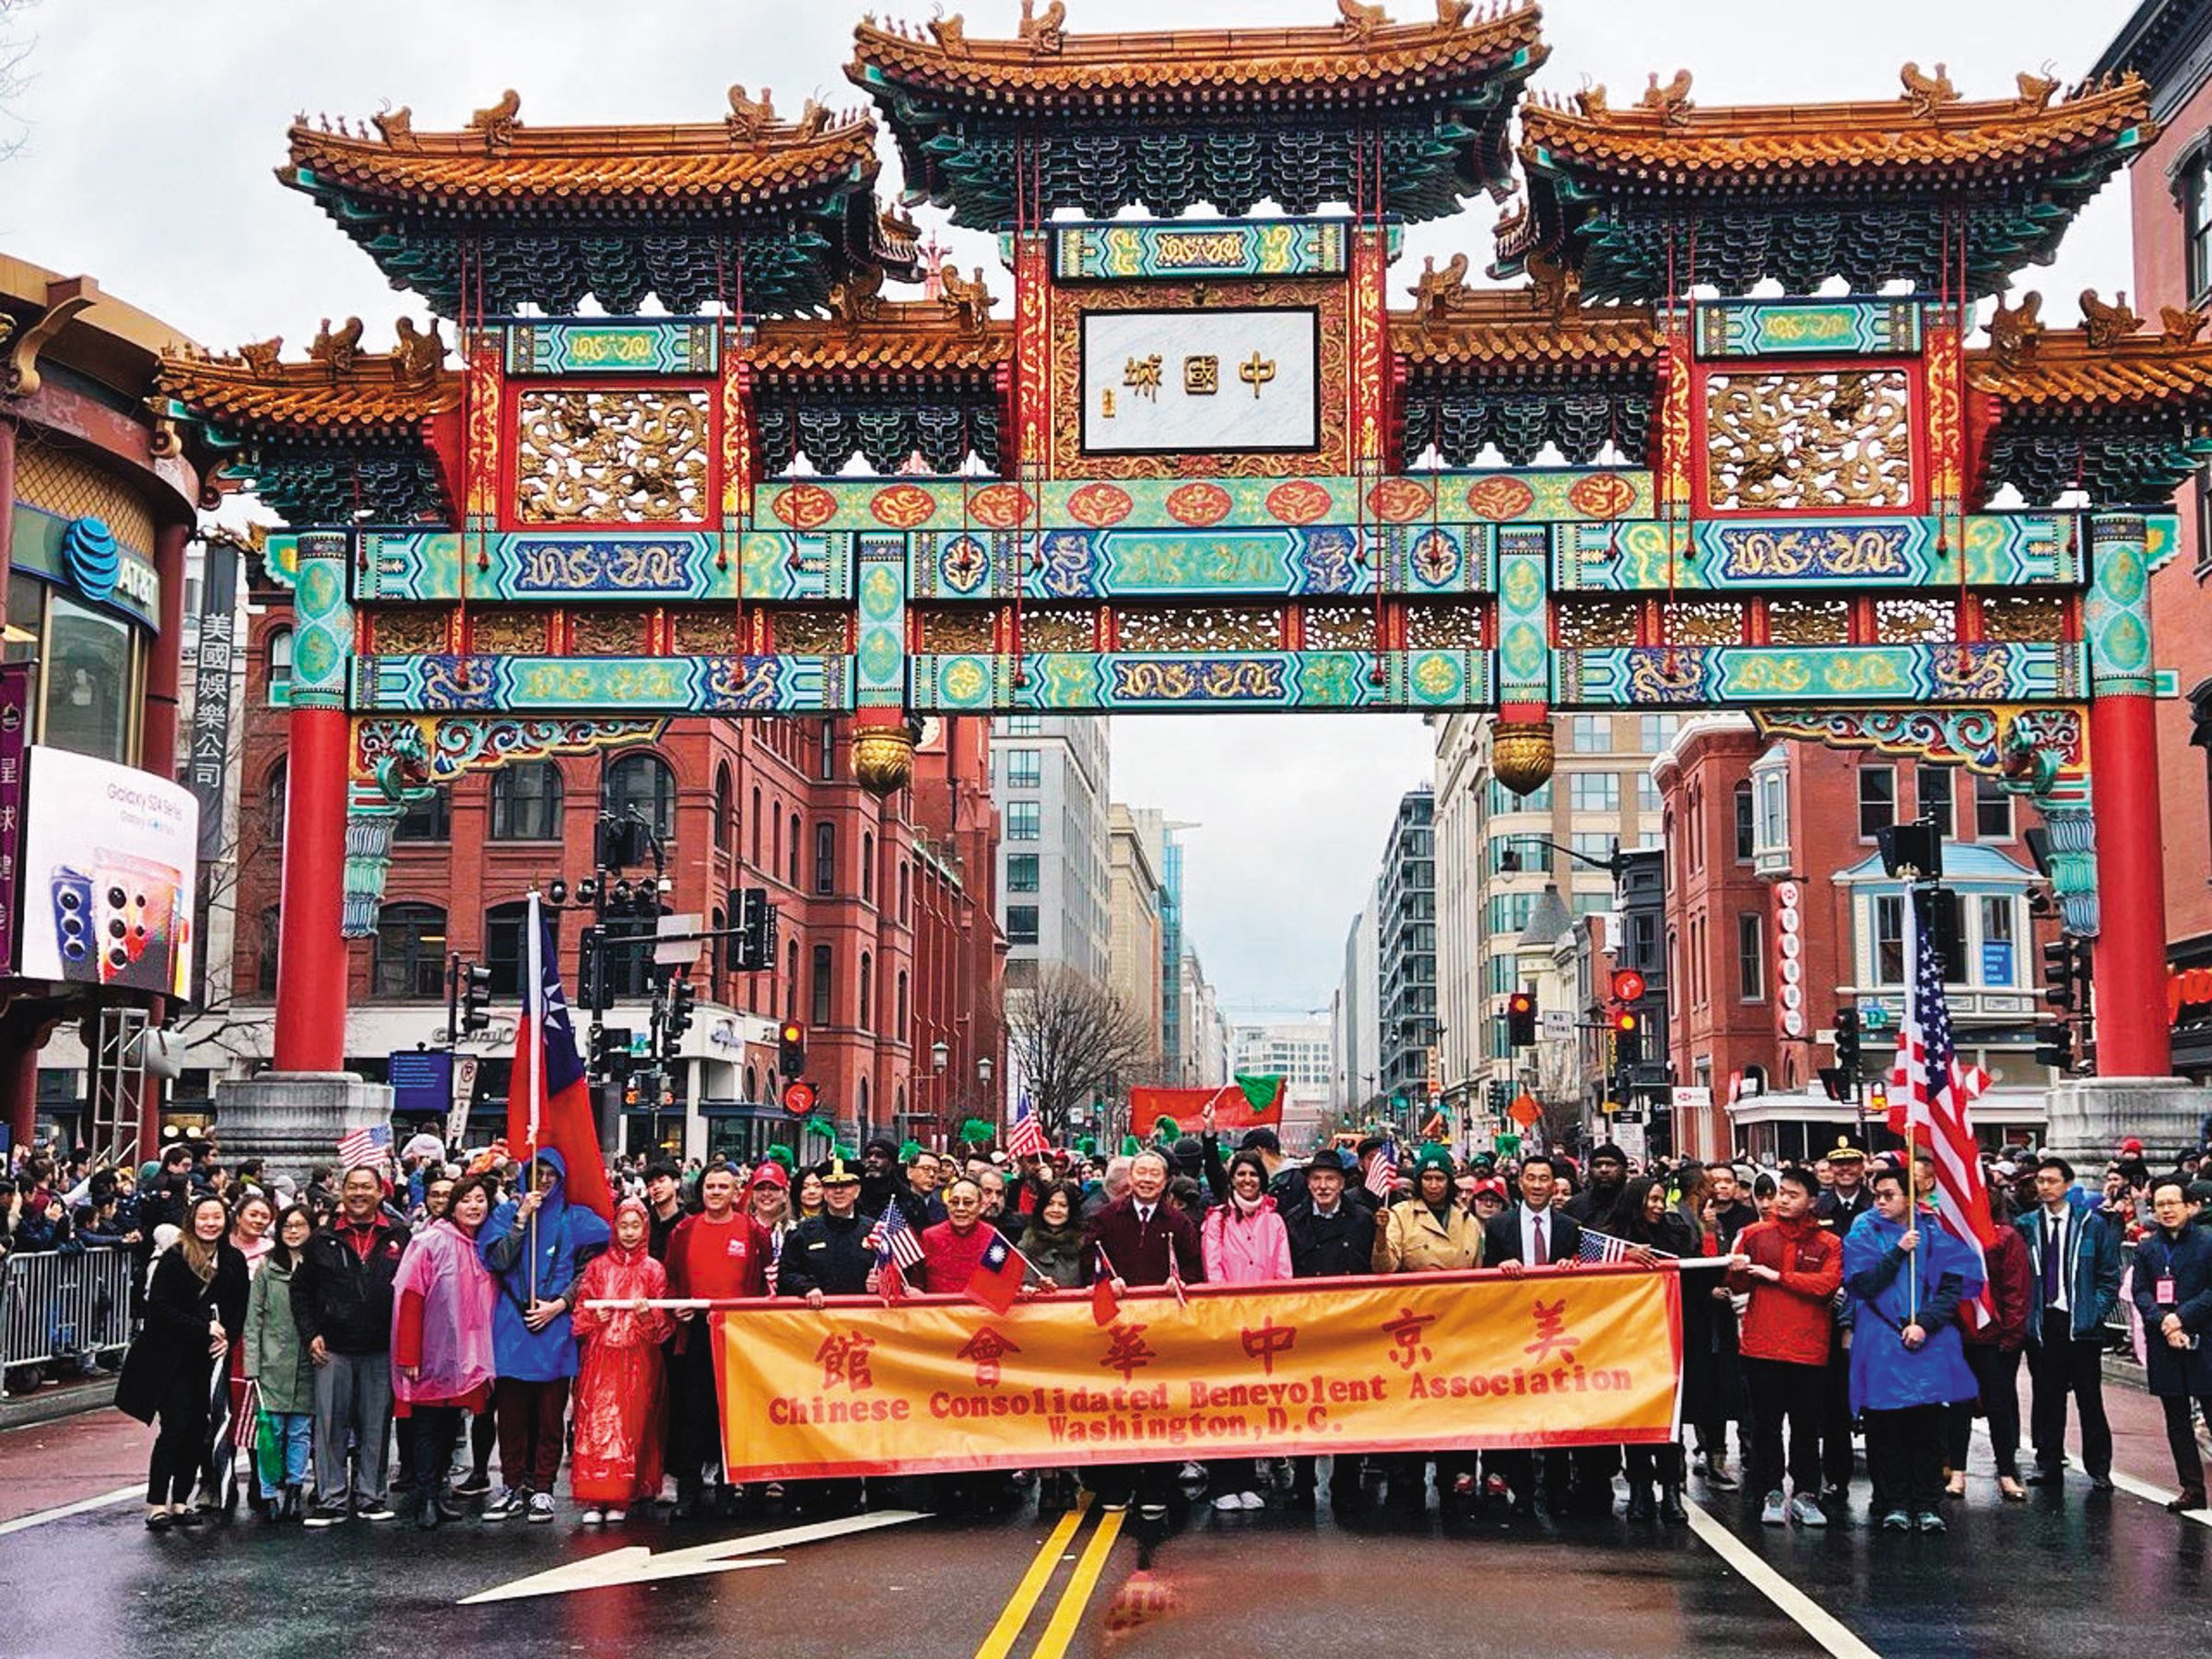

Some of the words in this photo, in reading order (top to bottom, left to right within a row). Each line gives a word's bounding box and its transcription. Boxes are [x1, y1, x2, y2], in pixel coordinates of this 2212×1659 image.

[194, 612, 232, 788] 美國娛樂公司
[768, 1395, 911, 1426] Chinese
[929, 1382, 1170, 1419] Consolidated
[1188, 1373, 1388, 1409] Benevolent
[1409, 1364, 1633, 1401] Association
